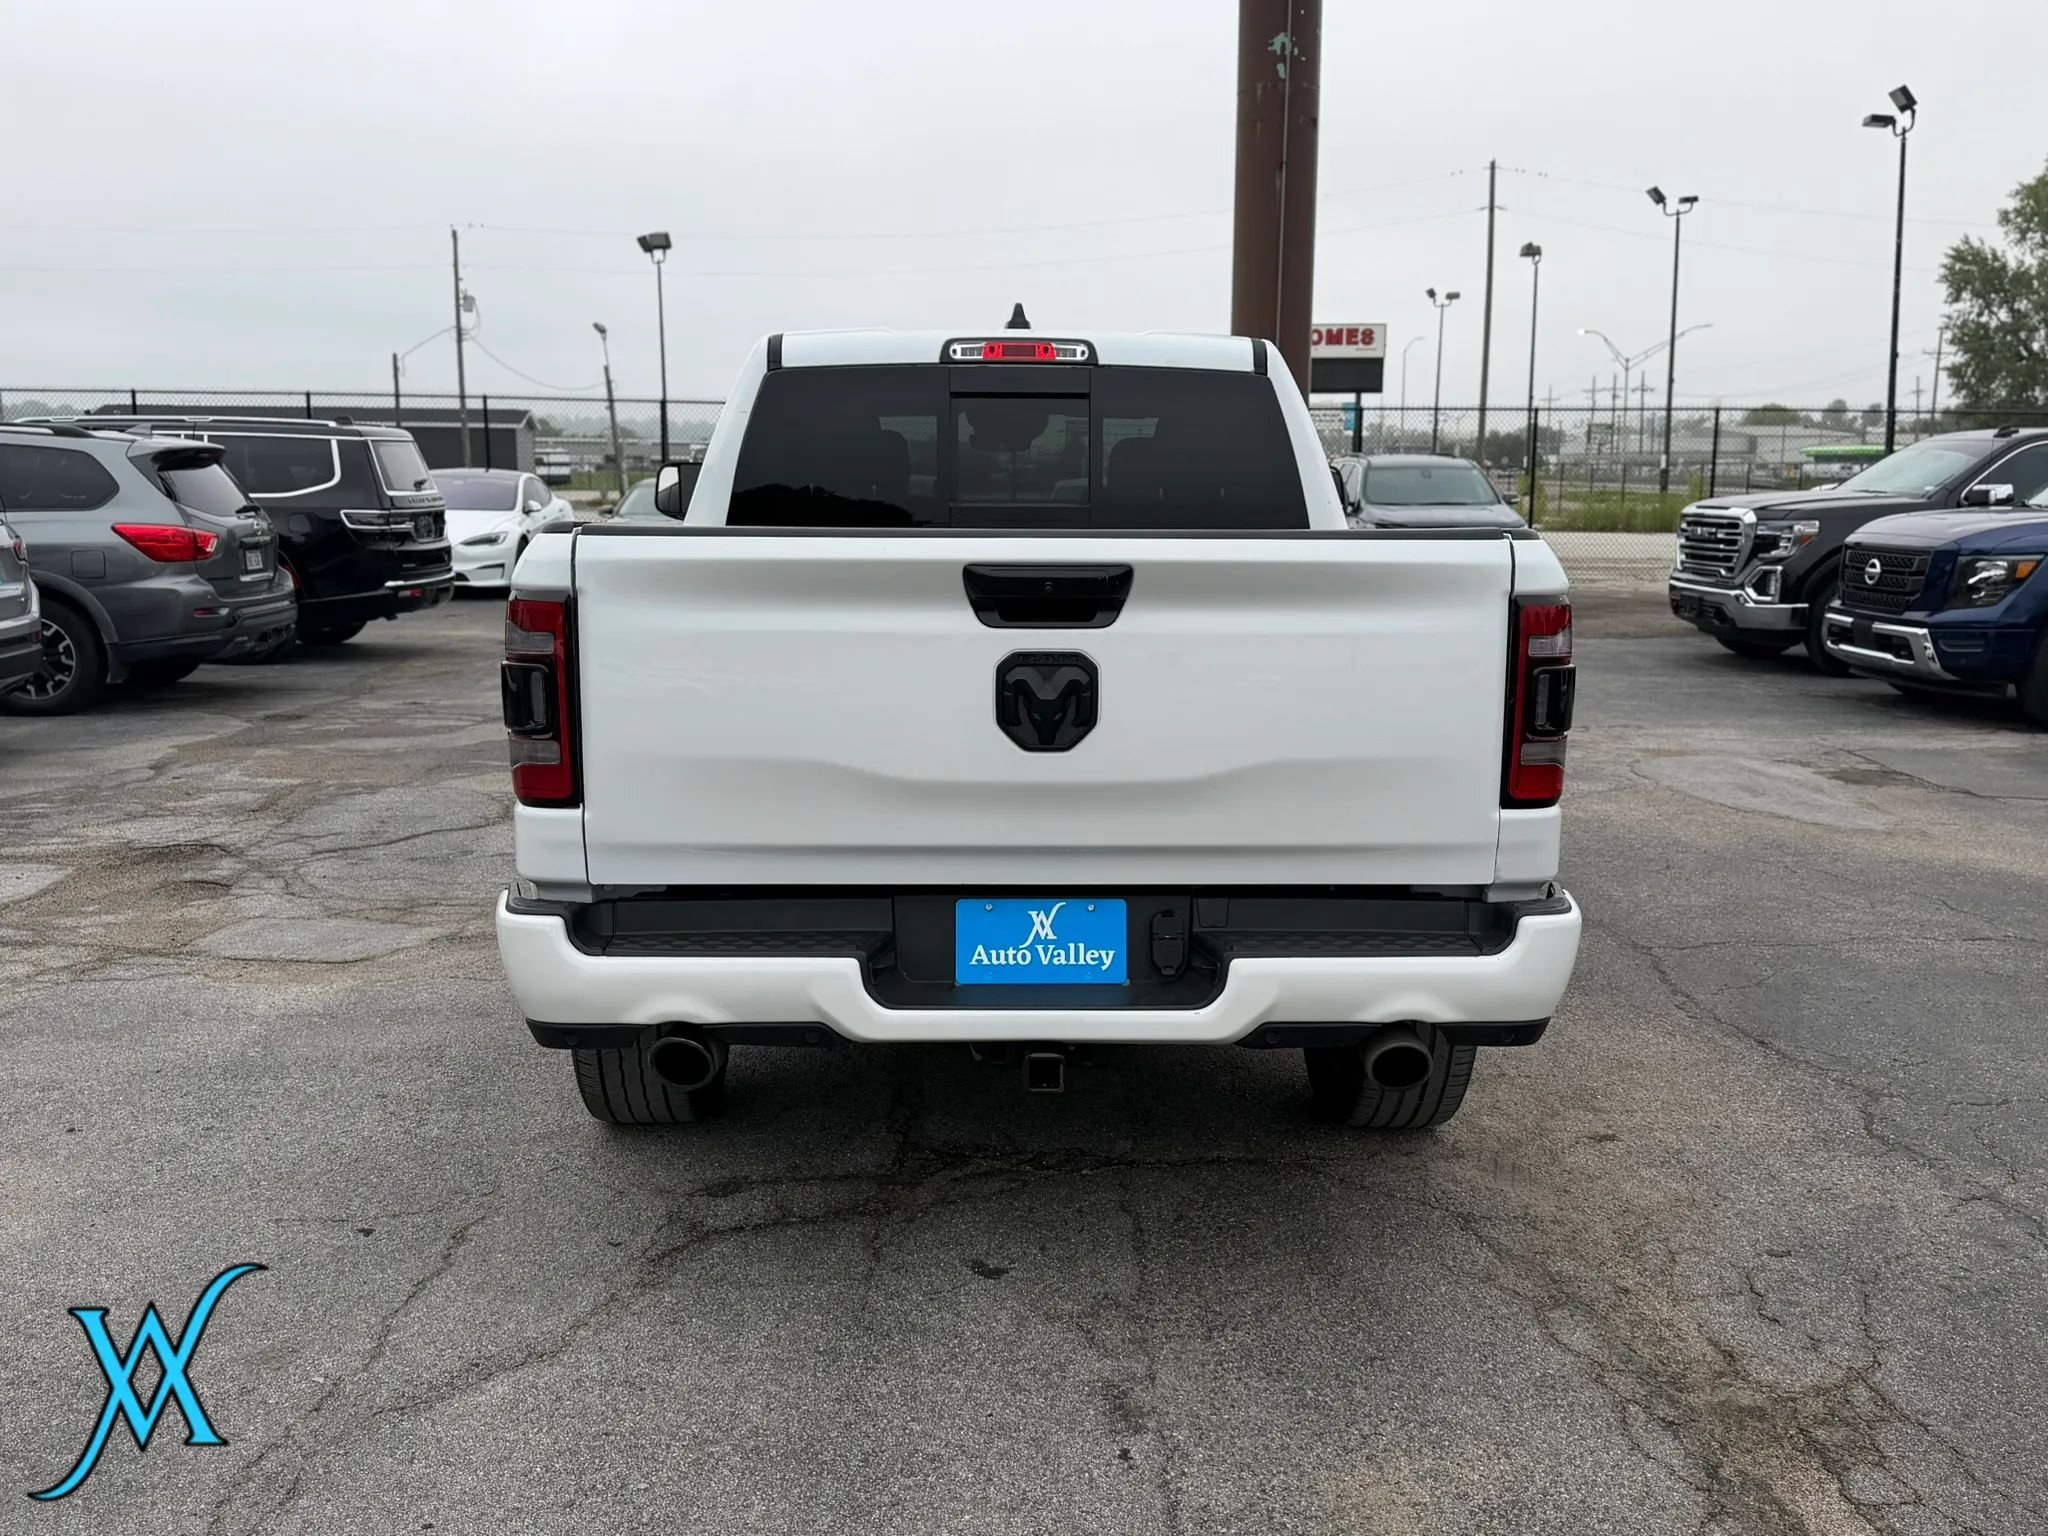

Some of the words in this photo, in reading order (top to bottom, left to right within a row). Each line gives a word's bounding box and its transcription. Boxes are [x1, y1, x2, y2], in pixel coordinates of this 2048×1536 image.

[1017, 653, 1079, 662] RAM
[969, 944, 1032, 966] Auto
[1035, 943, 1116, 970] Valley
